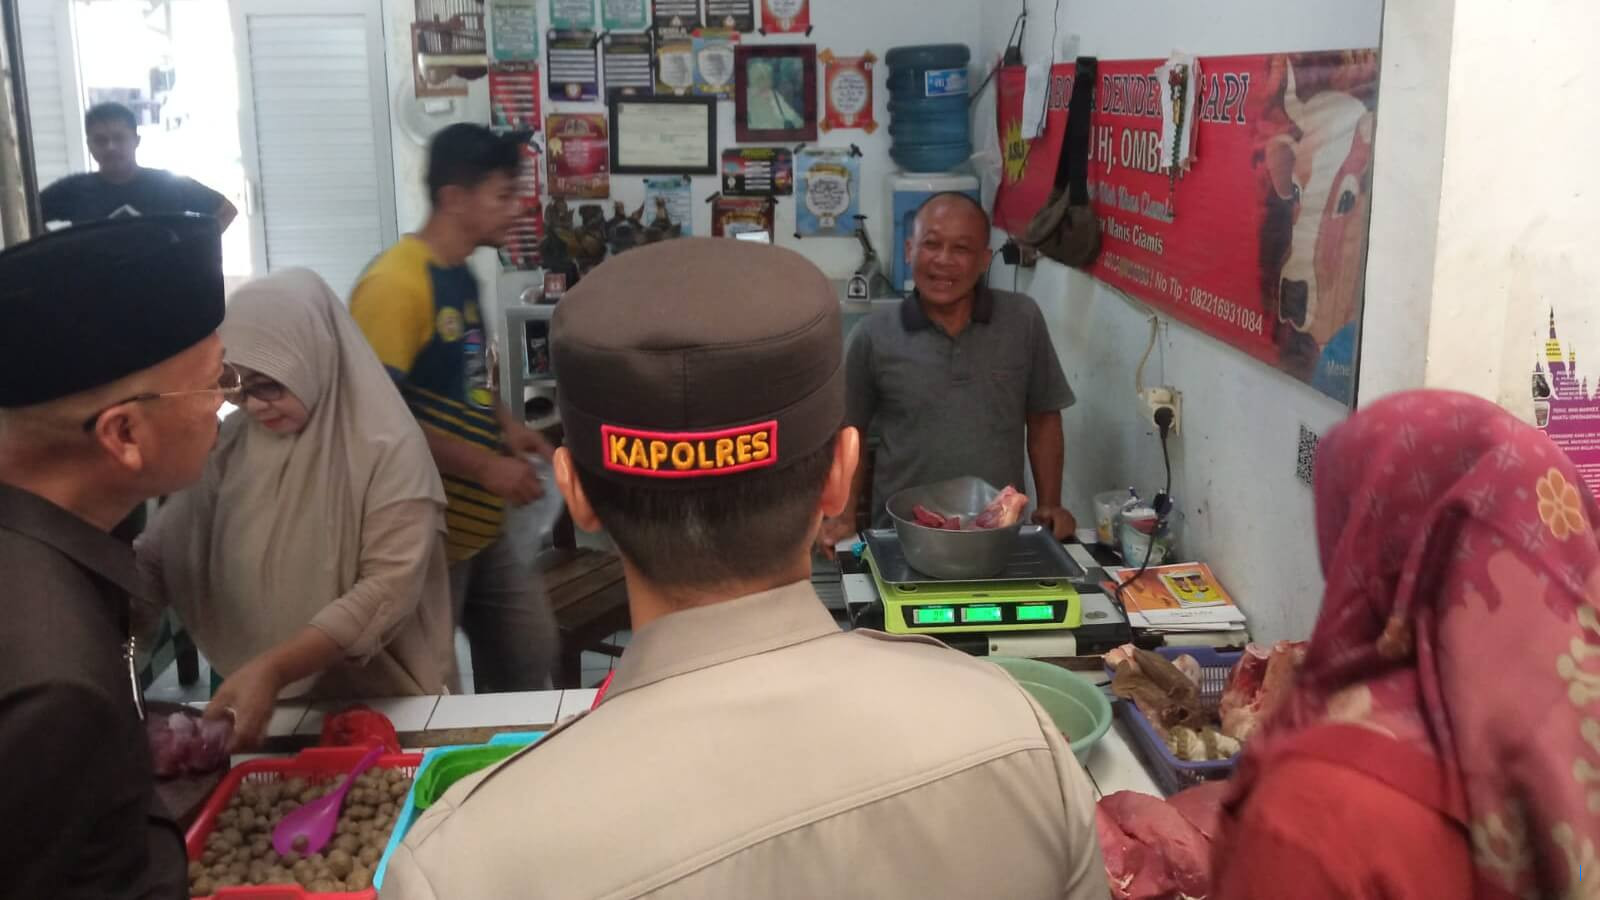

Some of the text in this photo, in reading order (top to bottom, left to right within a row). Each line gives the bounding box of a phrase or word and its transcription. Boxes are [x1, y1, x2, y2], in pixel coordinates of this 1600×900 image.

[1108, 215, 1130, 242] Manis
[1133, 224, 1164, 255] Ciamis
[1155, 271, 1167, 293] No
[1170, 277, 1183, 302] Tlp
[1190, 287, 1264, 335] 082216931084
[610, 432, 769, 472] KAPOLRES
